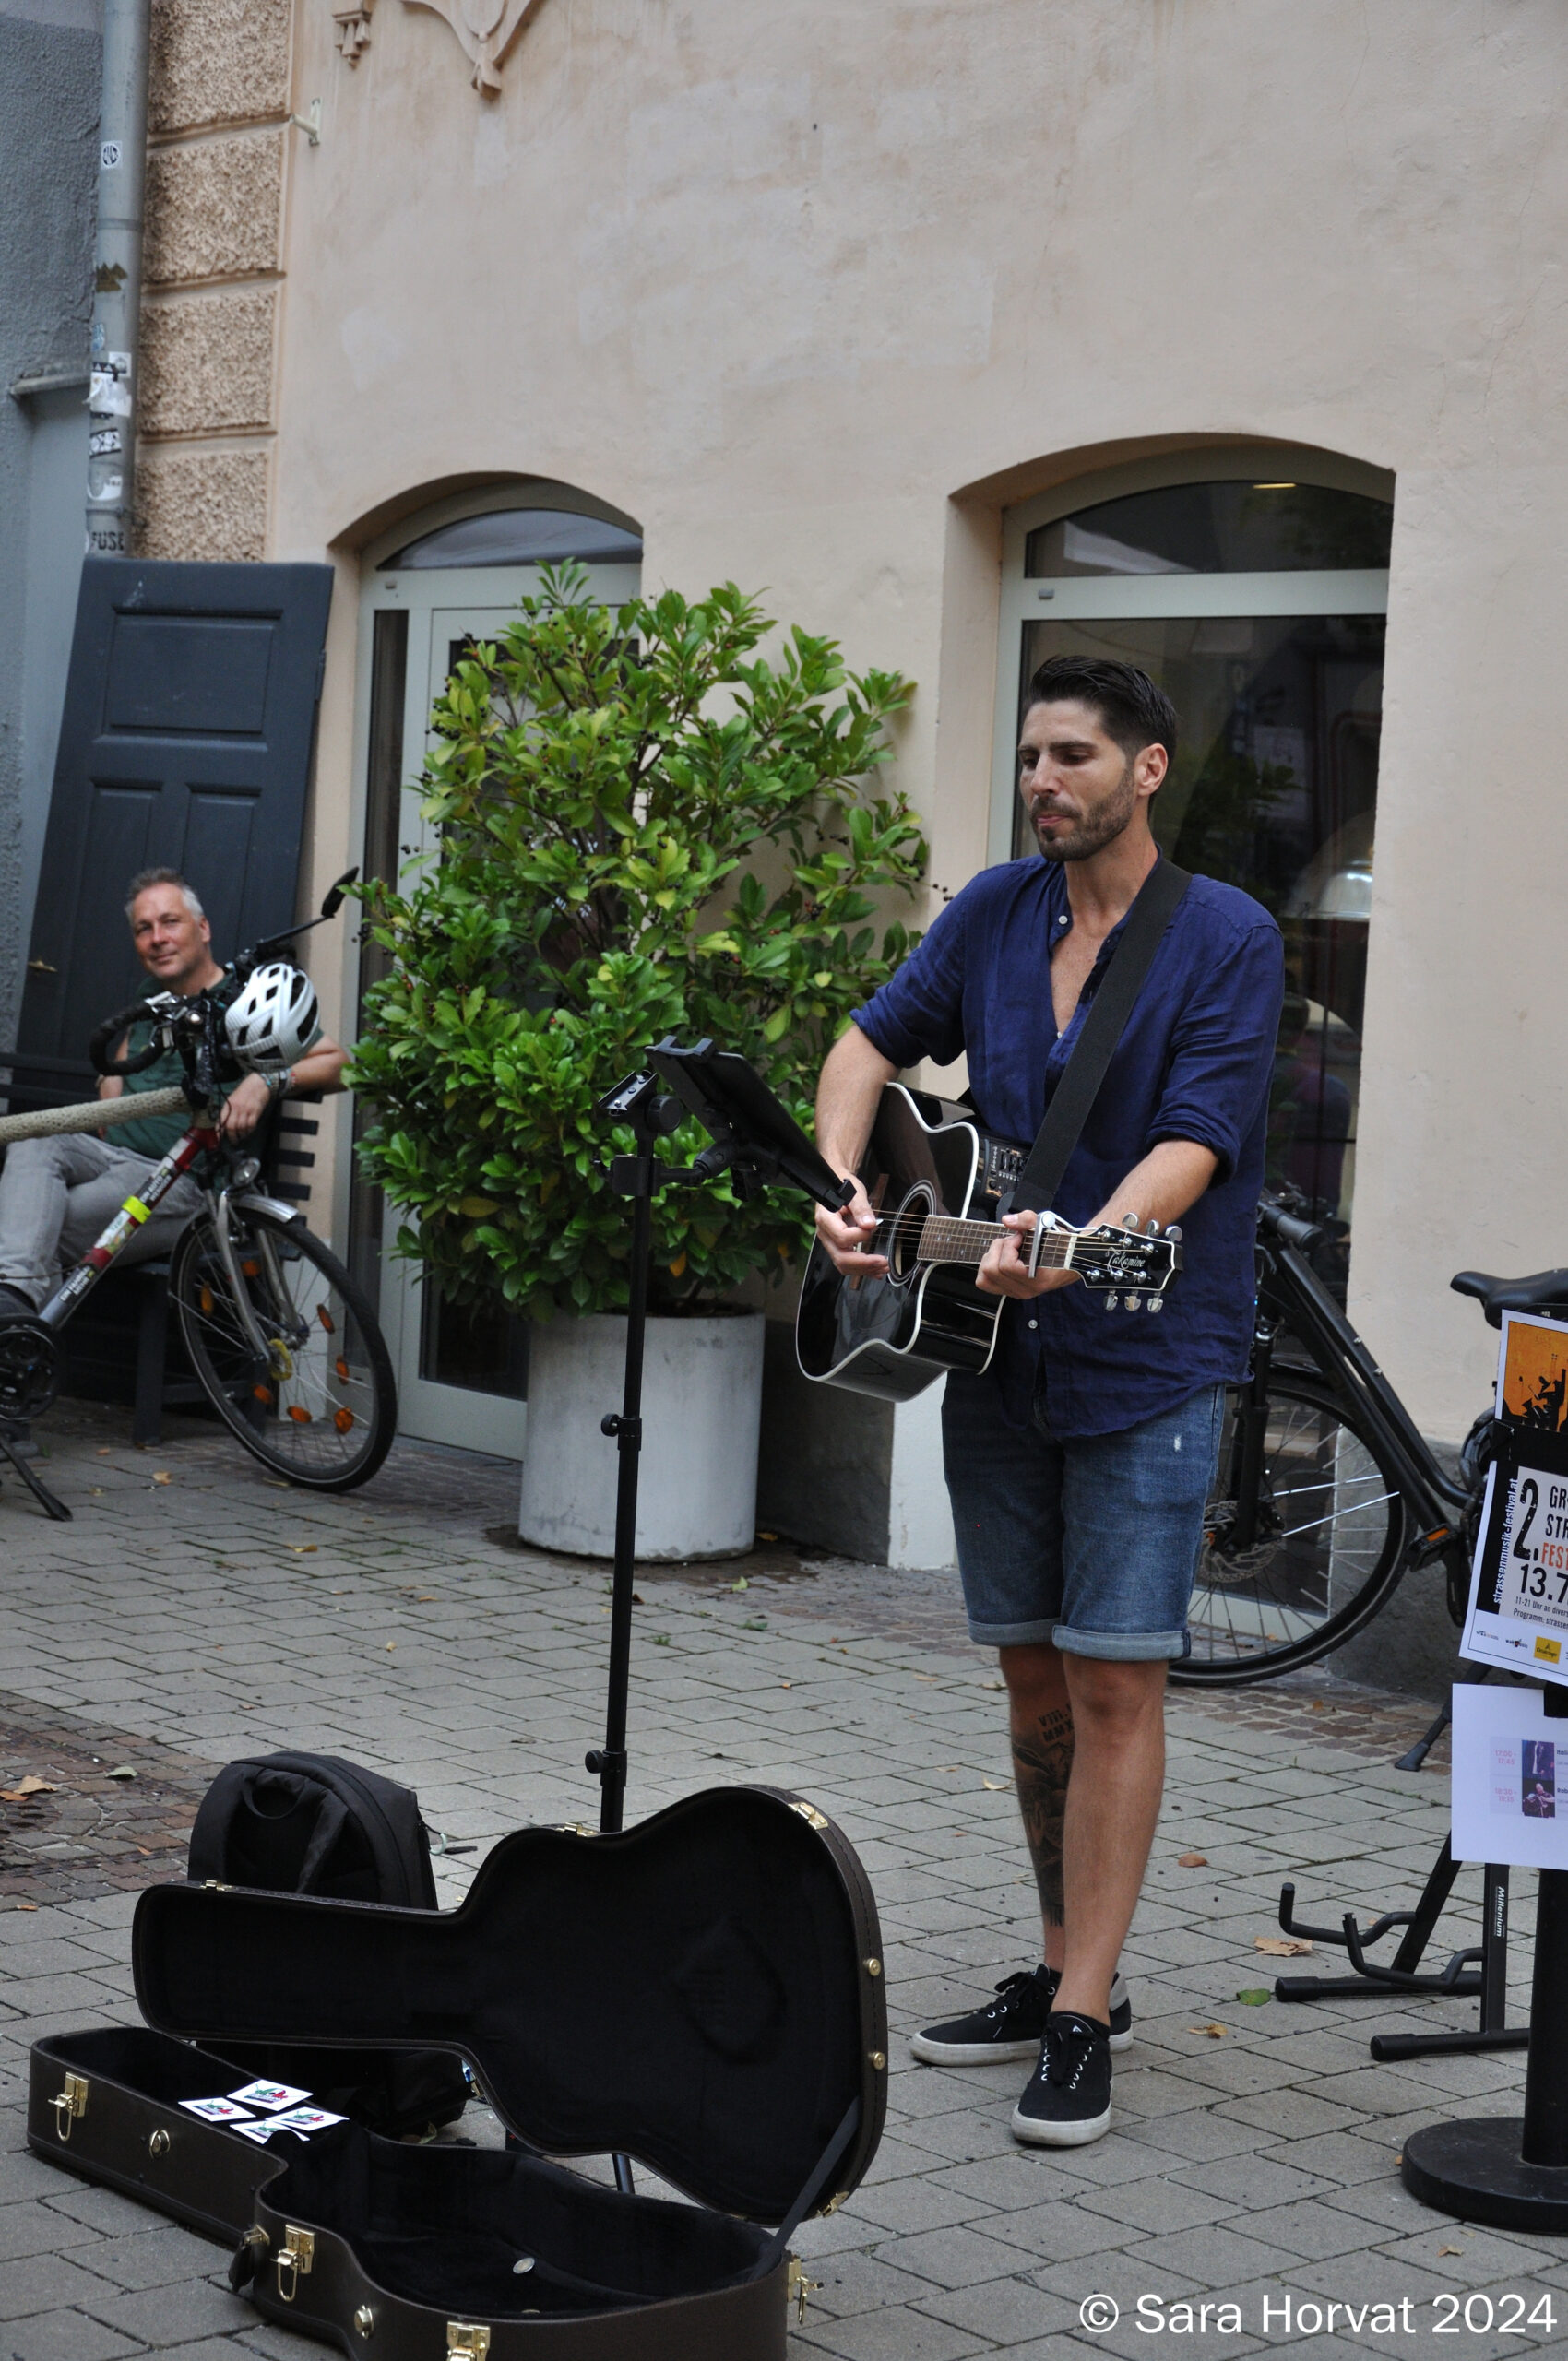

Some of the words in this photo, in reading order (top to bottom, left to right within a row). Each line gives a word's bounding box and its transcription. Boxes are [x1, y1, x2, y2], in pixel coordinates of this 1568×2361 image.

[1105, 1246, 1146, 1272] Takamine
[1550, 1485, 1568, 1511] GR
[1513, 1478, 1539, 1561] 2.
[1493, 1477, 1518, 1604] strassenmusik-festival.at
[1520, 1563, 1568, 1604] 13.7
[1513, 1608, 1544, 1623] Programm:
[1515, 1596, 1531, 1607] 11-21
[1532, 1601, 1543, 1610] Uhr
[1496, 1886, 1505, 1937] Millenium
